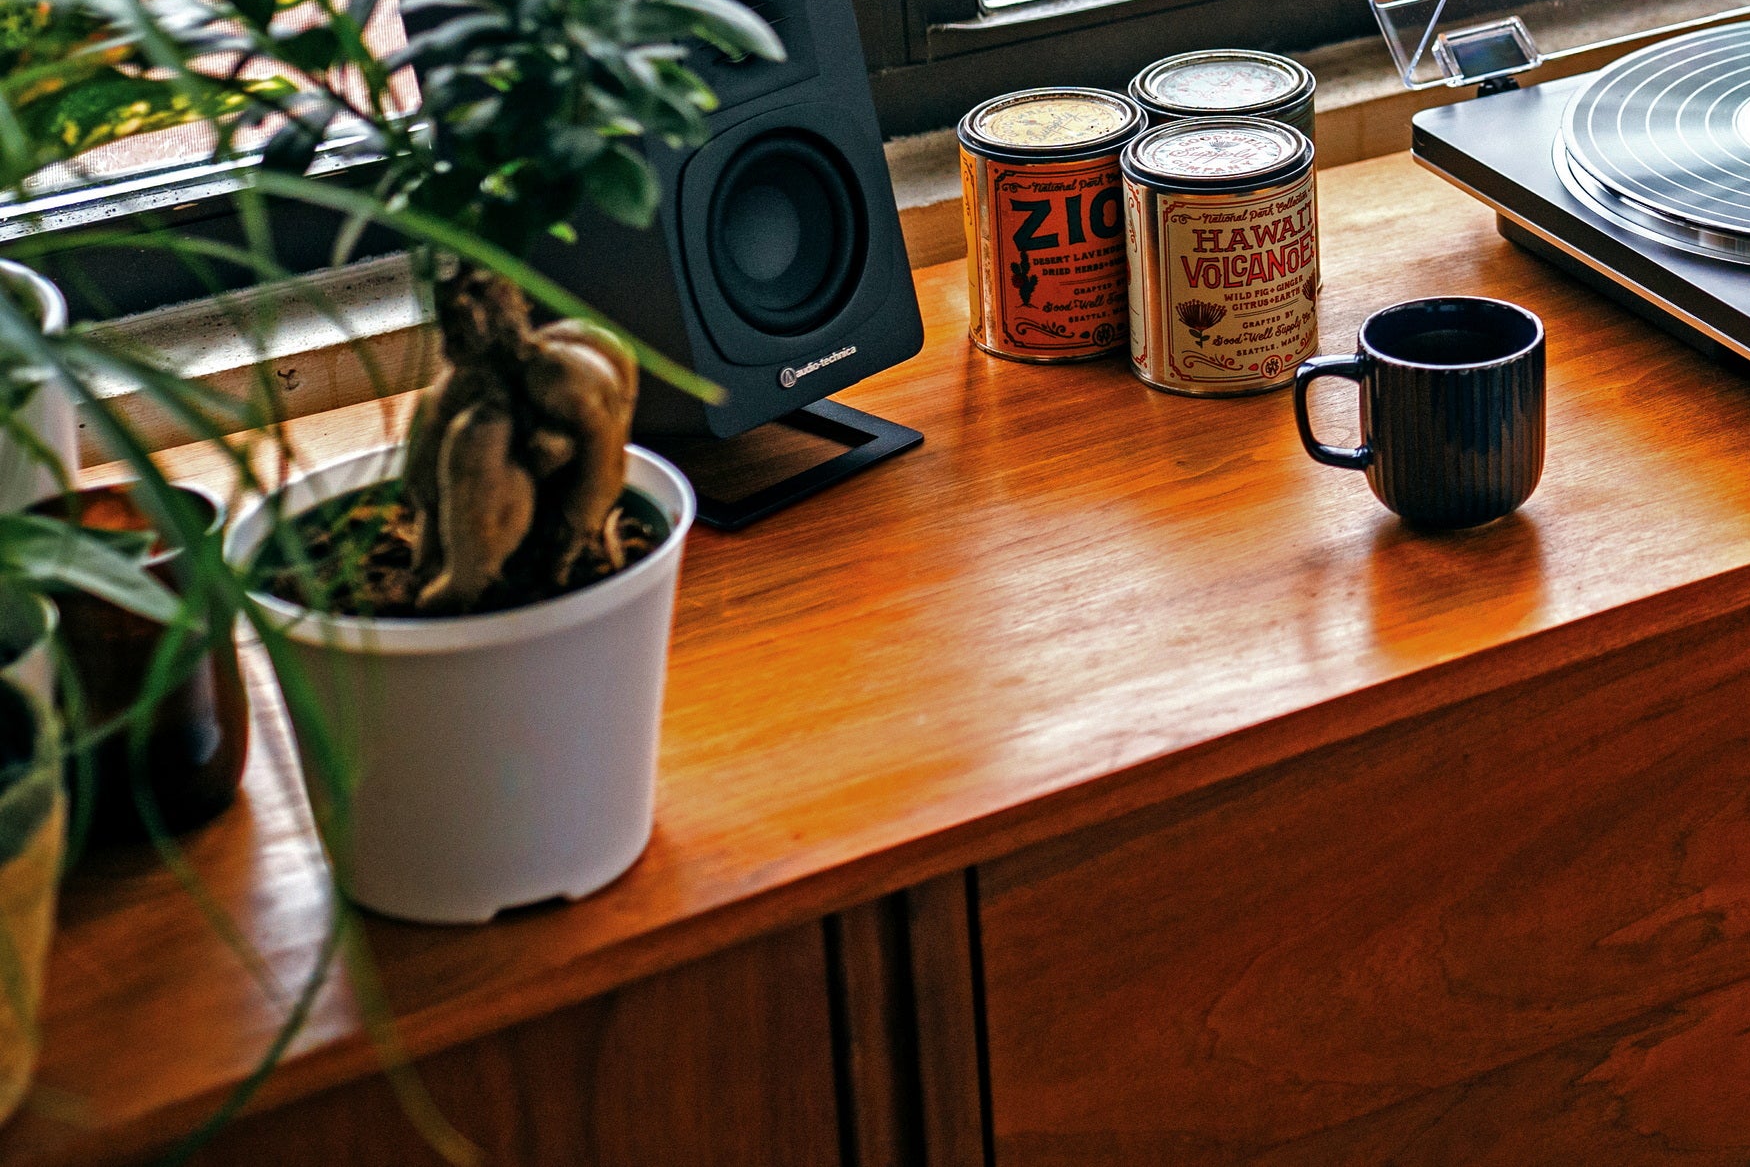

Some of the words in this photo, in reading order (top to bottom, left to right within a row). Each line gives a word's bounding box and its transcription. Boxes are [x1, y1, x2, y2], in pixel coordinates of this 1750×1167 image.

[1031, 178, 1077, 193] National
[1079, 174, 1104, 191] Park
[1009, 186, 1126, 252] ZIO
[1202, 209, 1248, 224] National
[1249, 203, 1275, 222] Park
[1033, 255, 1070, 266] DESERT
[1073, 243, 1126, 262] LAVENDE
[1042, 267, 1071, 276] DRIED
[1074, 282, 1113, 295] CRAFTED
[1224, 291, 1252, 302] WILD
[1254, 288, 1269, 298] FIG
[1276, 274, 1304, 292] GINGER
[1232, 297, 1269, 311] CITRUS
[1275, 286, 1301, 303] EARTH
[1242, 315, 1281, 329] CRAFTED
[1285, 309, 1294, 319] BY
[1275, 315, 1302, 337] Supply
[795, 346, 857, 379] audio-technica
